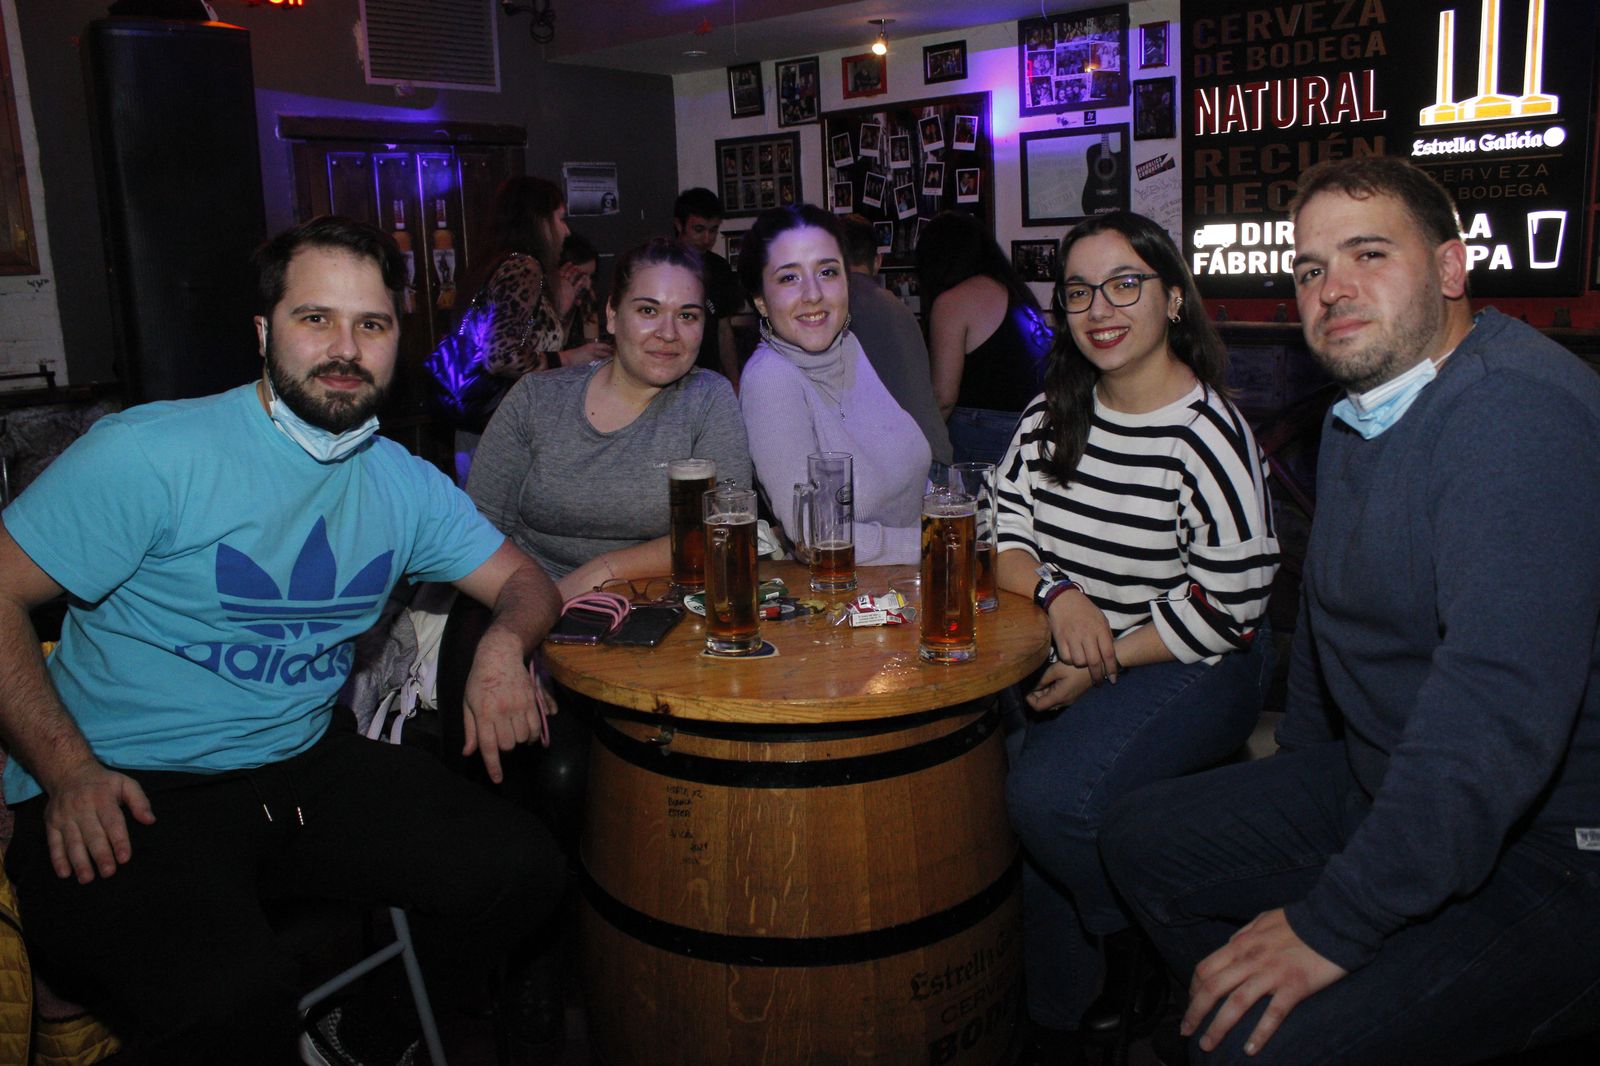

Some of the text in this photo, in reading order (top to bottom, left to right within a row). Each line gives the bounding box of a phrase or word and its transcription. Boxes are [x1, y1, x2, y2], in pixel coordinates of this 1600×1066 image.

[1193, 0, 1388, 49] CERVEZA
[1193, 31, 1389, 78] DE BODEGA
[1194, 69, 1387, 137] NATURAL
[1411, 130, 1544, 156] Estrella Galicia
[1194, 180, 1298, 216] HEC
[1458, 182, 1548, 200] BODEGA
[1193, 247, 1297, 275] FÁBRIC
[1465, 244, 1513, 270] PA
